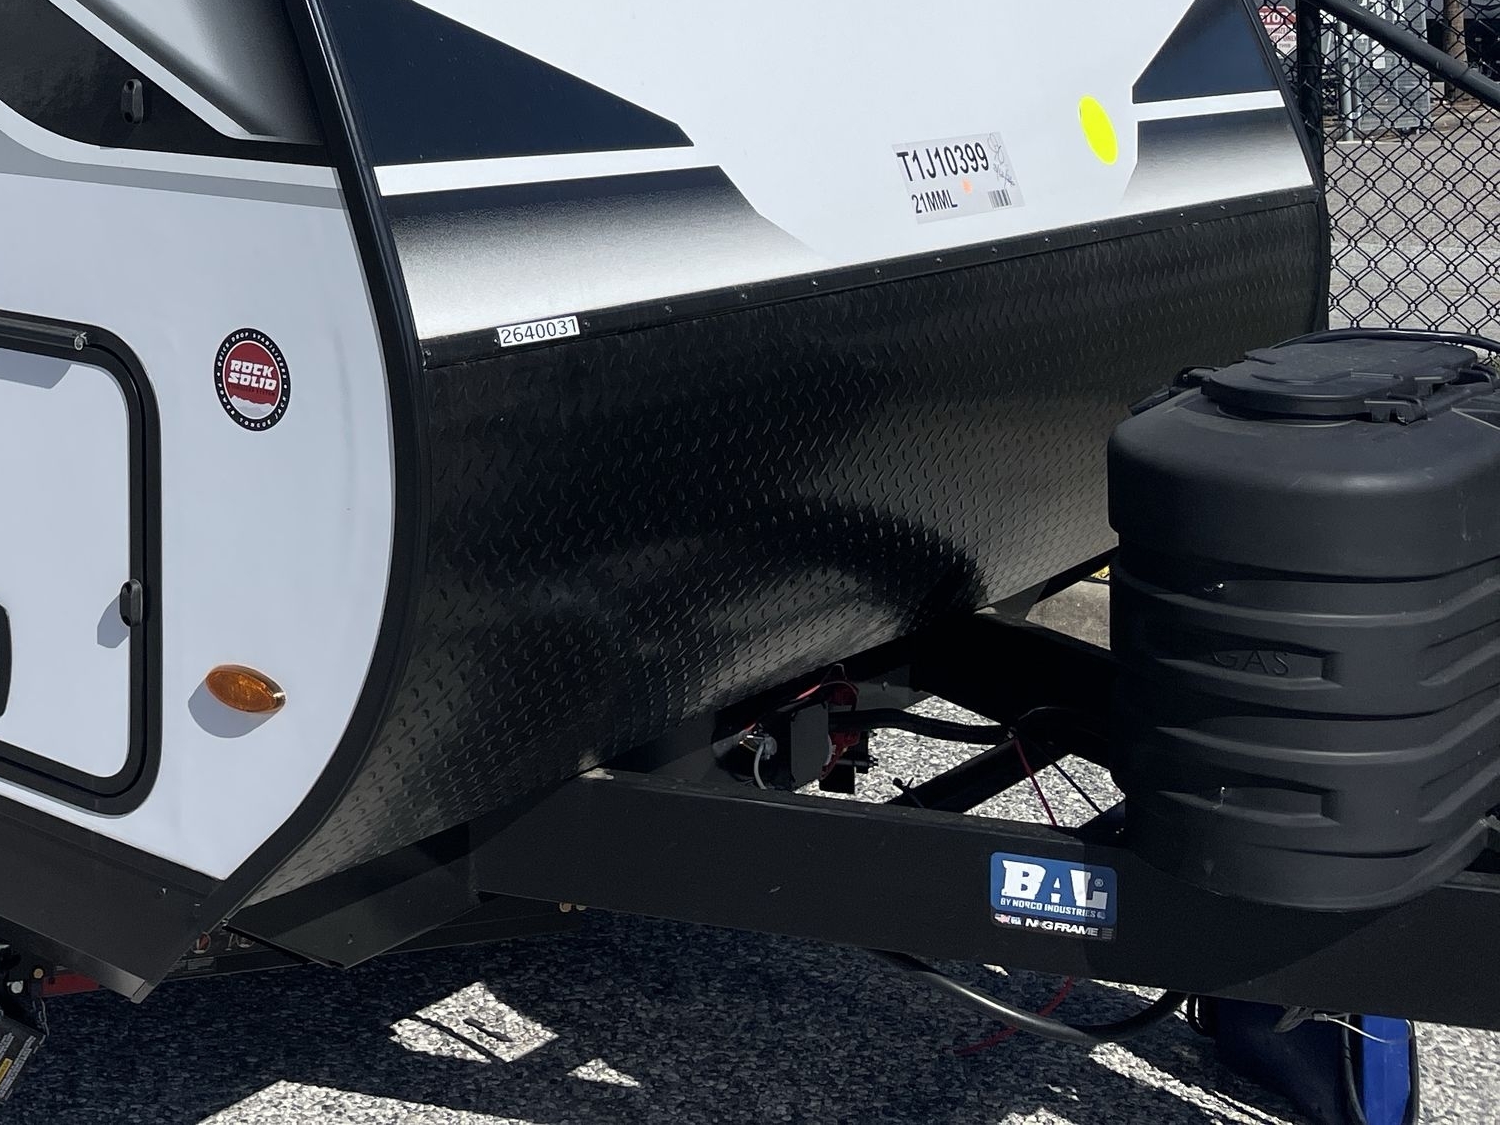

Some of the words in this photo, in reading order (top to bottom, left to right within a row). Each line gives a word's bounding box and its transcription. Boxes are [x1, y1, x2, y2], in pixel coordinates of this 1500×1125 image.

[896, 141, 990, 182] T1J10399
[911, 189, 959, 214] 21MML
[500, 318, 577, 344] 2640031
[230, 359, 275, 377] ROCK
[227, 371, 277, 391] SOLID
[1212, 650, 1289, 675] GAS
[1000, 859, 1109, 910] BAL
[1000, 897, 1011, 907] BY
[1012, 898, 1043, 911] NORCO
[1044, 903, 1097, 918] INDUSTRIES
